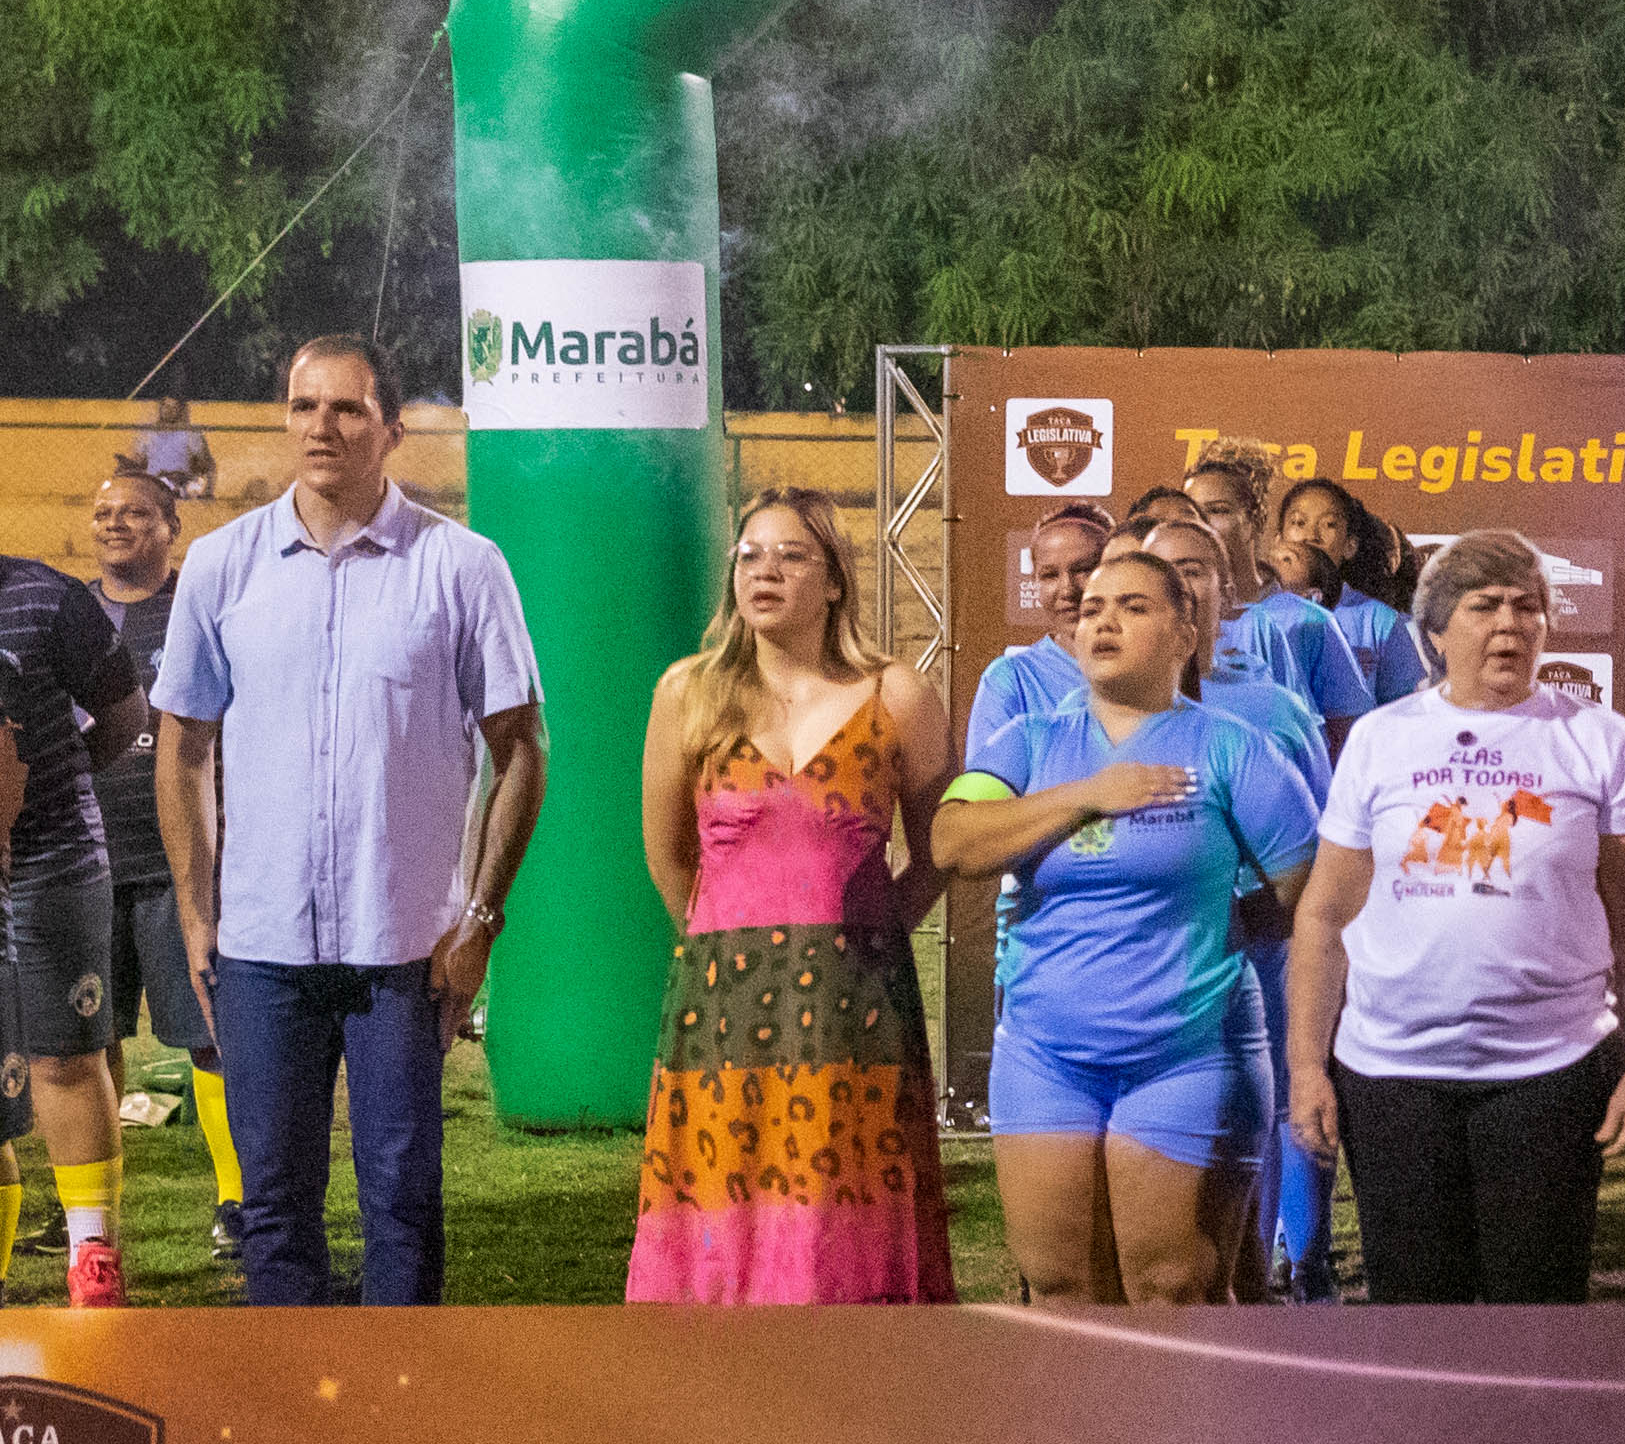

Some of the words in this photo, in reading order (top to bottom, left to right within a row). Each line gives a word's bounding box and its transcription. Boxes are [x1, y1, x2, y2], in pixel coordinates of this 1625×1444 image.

[511, 317, 698, 366] Marabá
[512, 372, 699, 384] PREFEITURA
[1027, 428, 1092, 444] LEGISLATIVA
[1412, 768, 1453, 788] POR
[1464, 769, 1543, 788] TODAS!
